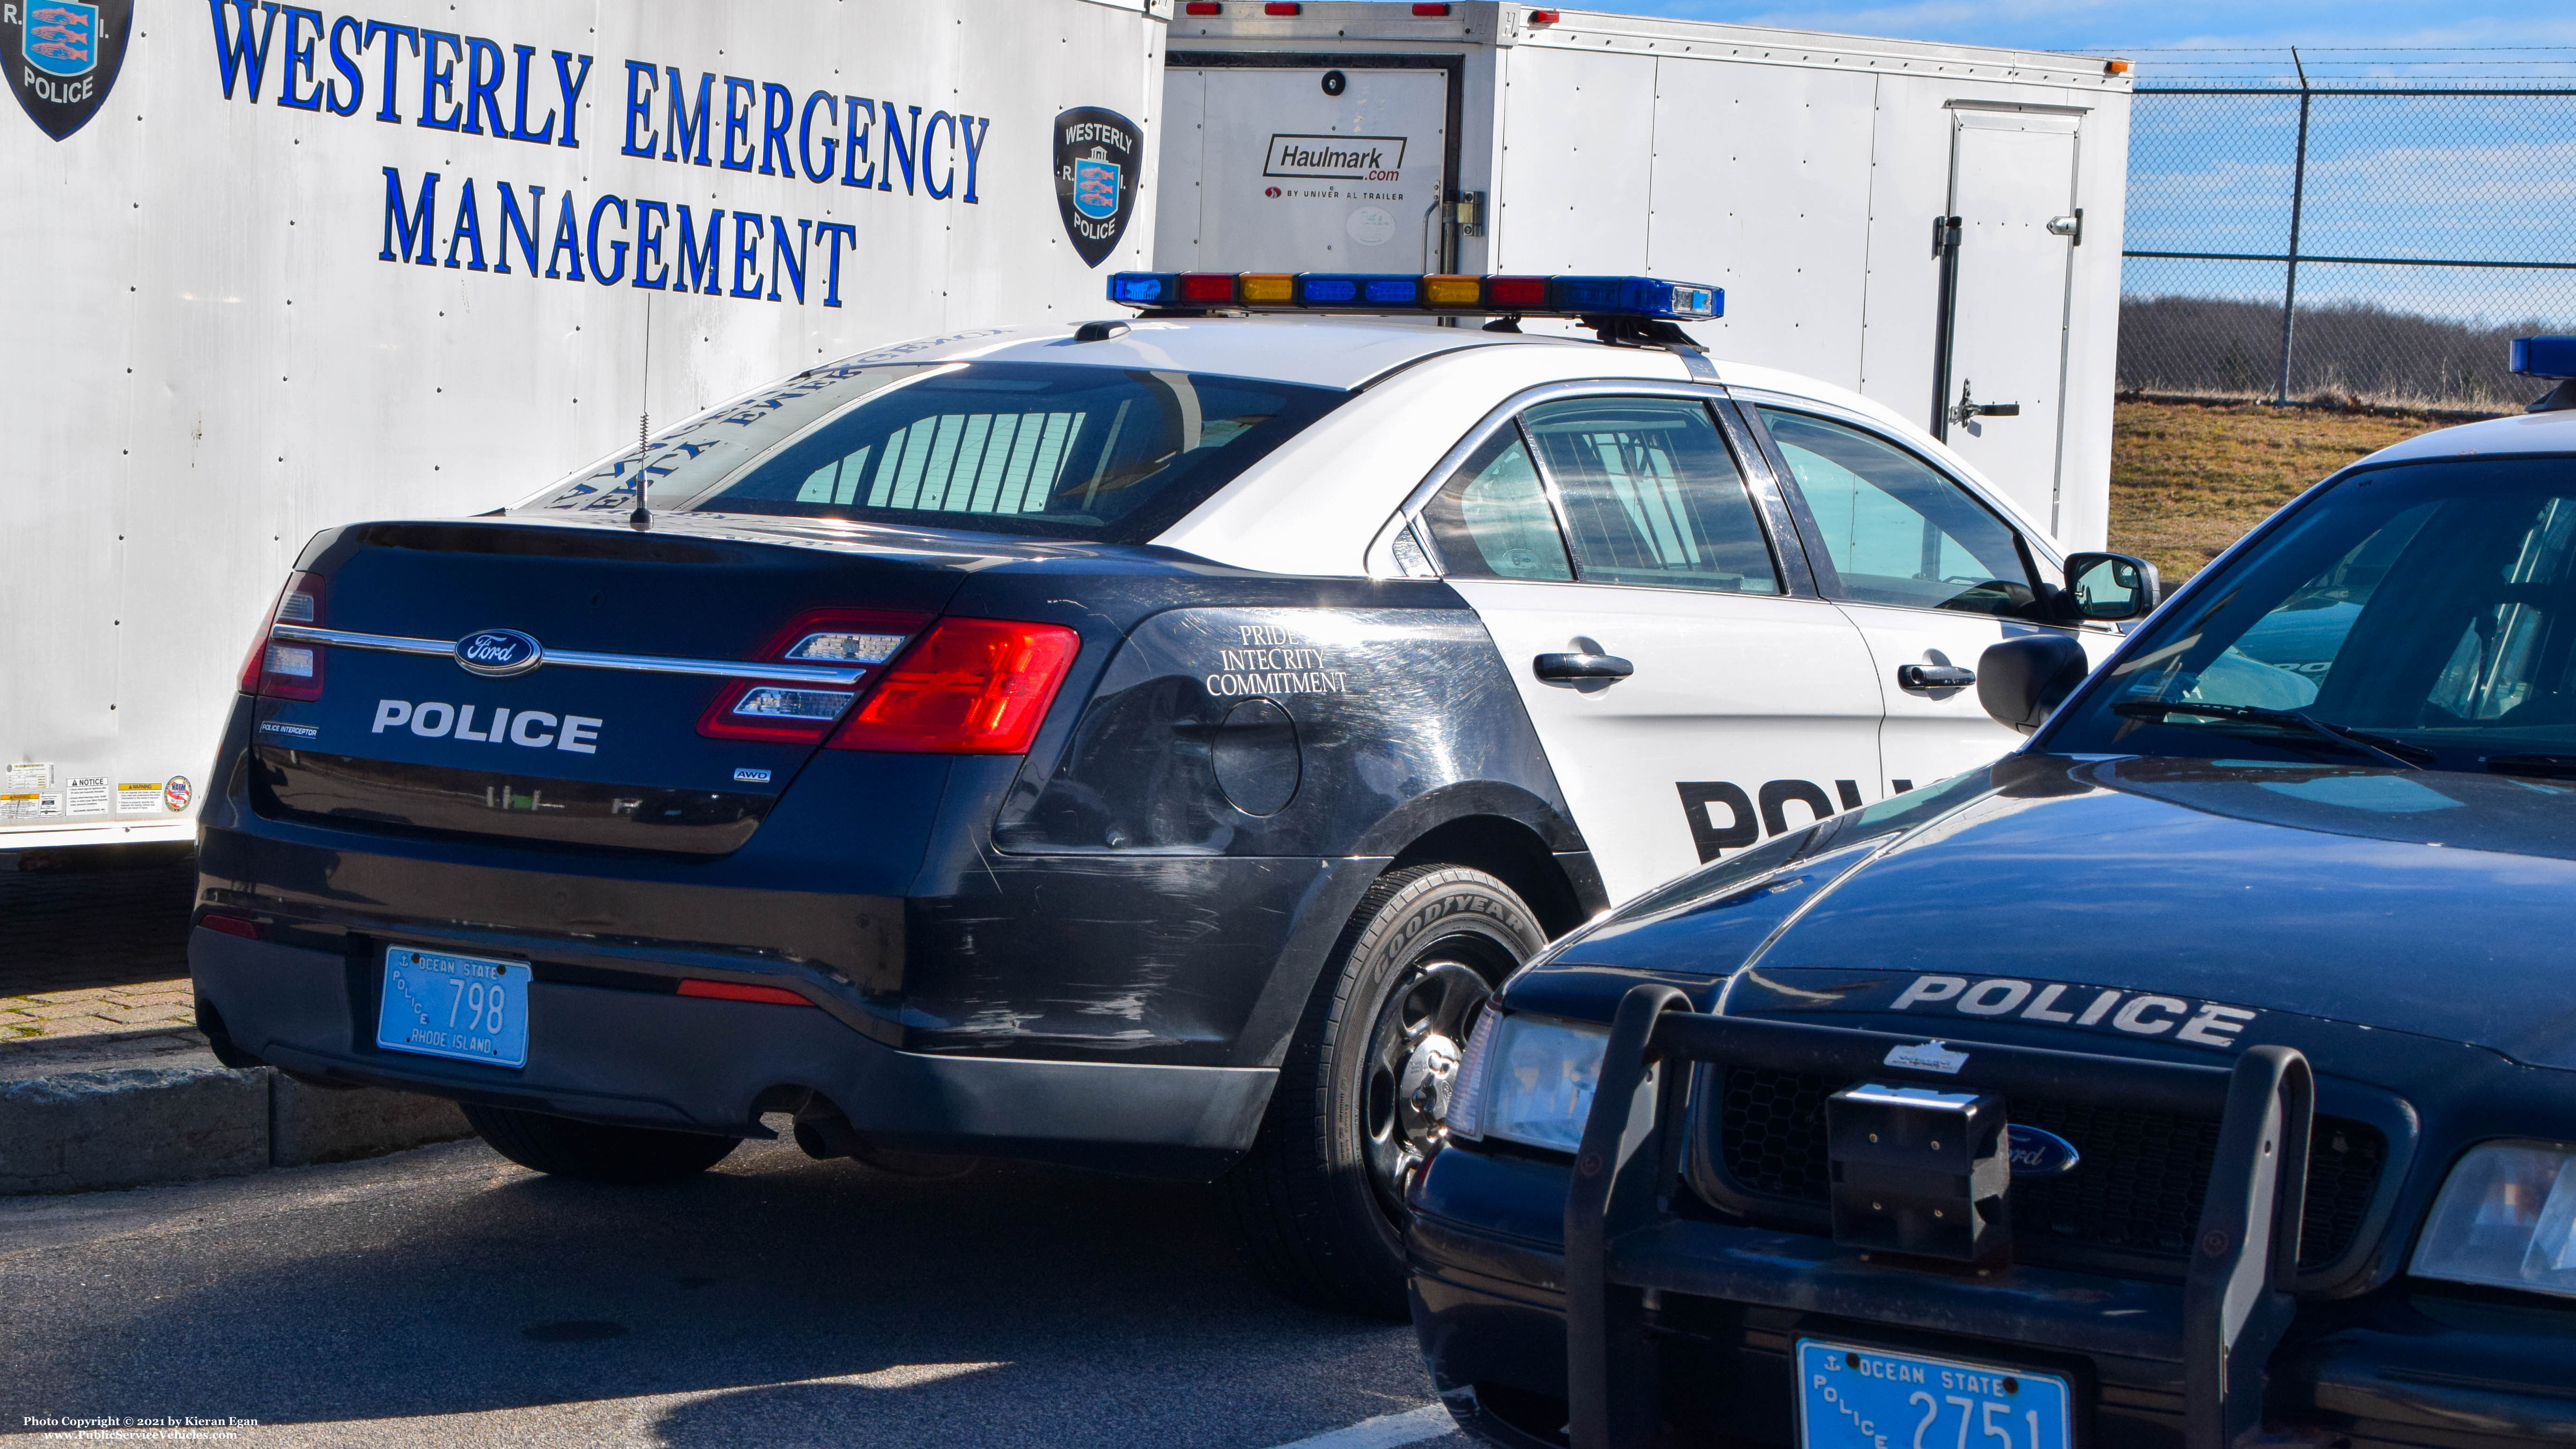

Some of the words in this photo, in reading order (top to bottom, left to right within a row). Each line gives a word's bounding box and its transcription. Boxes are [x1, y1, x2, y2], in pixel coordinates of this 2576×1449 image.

[4, 3, 22, 25] R.
[24, 66, 93, 104] POLICE
[208, 0, 594, 149] WESTERLY
[621, 59, 990, 204] EMERGENCY
[1066, 123, 1132, 154] WESTERLY
[1281, 145, 1383, 169] Haulmark
[1063, 165, 1074, 181] R.
[1364, 170, 1399, 181] .com
[379, 166, 856, 308] MANAGEMENT
[1074, 211, 1116, 239] POLICE
[467, 634, 516, 661] Ford
[1239, 625, 1299, 645] PRIDE
[1206, 672, 1347, 696] COMMITMENT
[281, 726, 317, 736] INTERCEPTOR
[372, 699, 603, 754] POLICE
[1374, 895, 1523, 984] GOODYEAR
[419, 957, 455, 974] OCEAN
[463, 963, 498, 980] STATE
[393, 971, 428, 1025] POLICE
[449, 978, 505, 1034] 798
[1890, 975, 2257, 1048] POLICE
[411, 1028, 447, 1048] RHODE
[452, 1034, 491, 1054] ISLAND
[1859, 1359, 1925, 1384] OCEAN
[1942, 1371, 2004, 1397] STATE
[1814, 1375, 1888, 1449] POLICE
[1909, 1391, 2039, 1449] 2751
